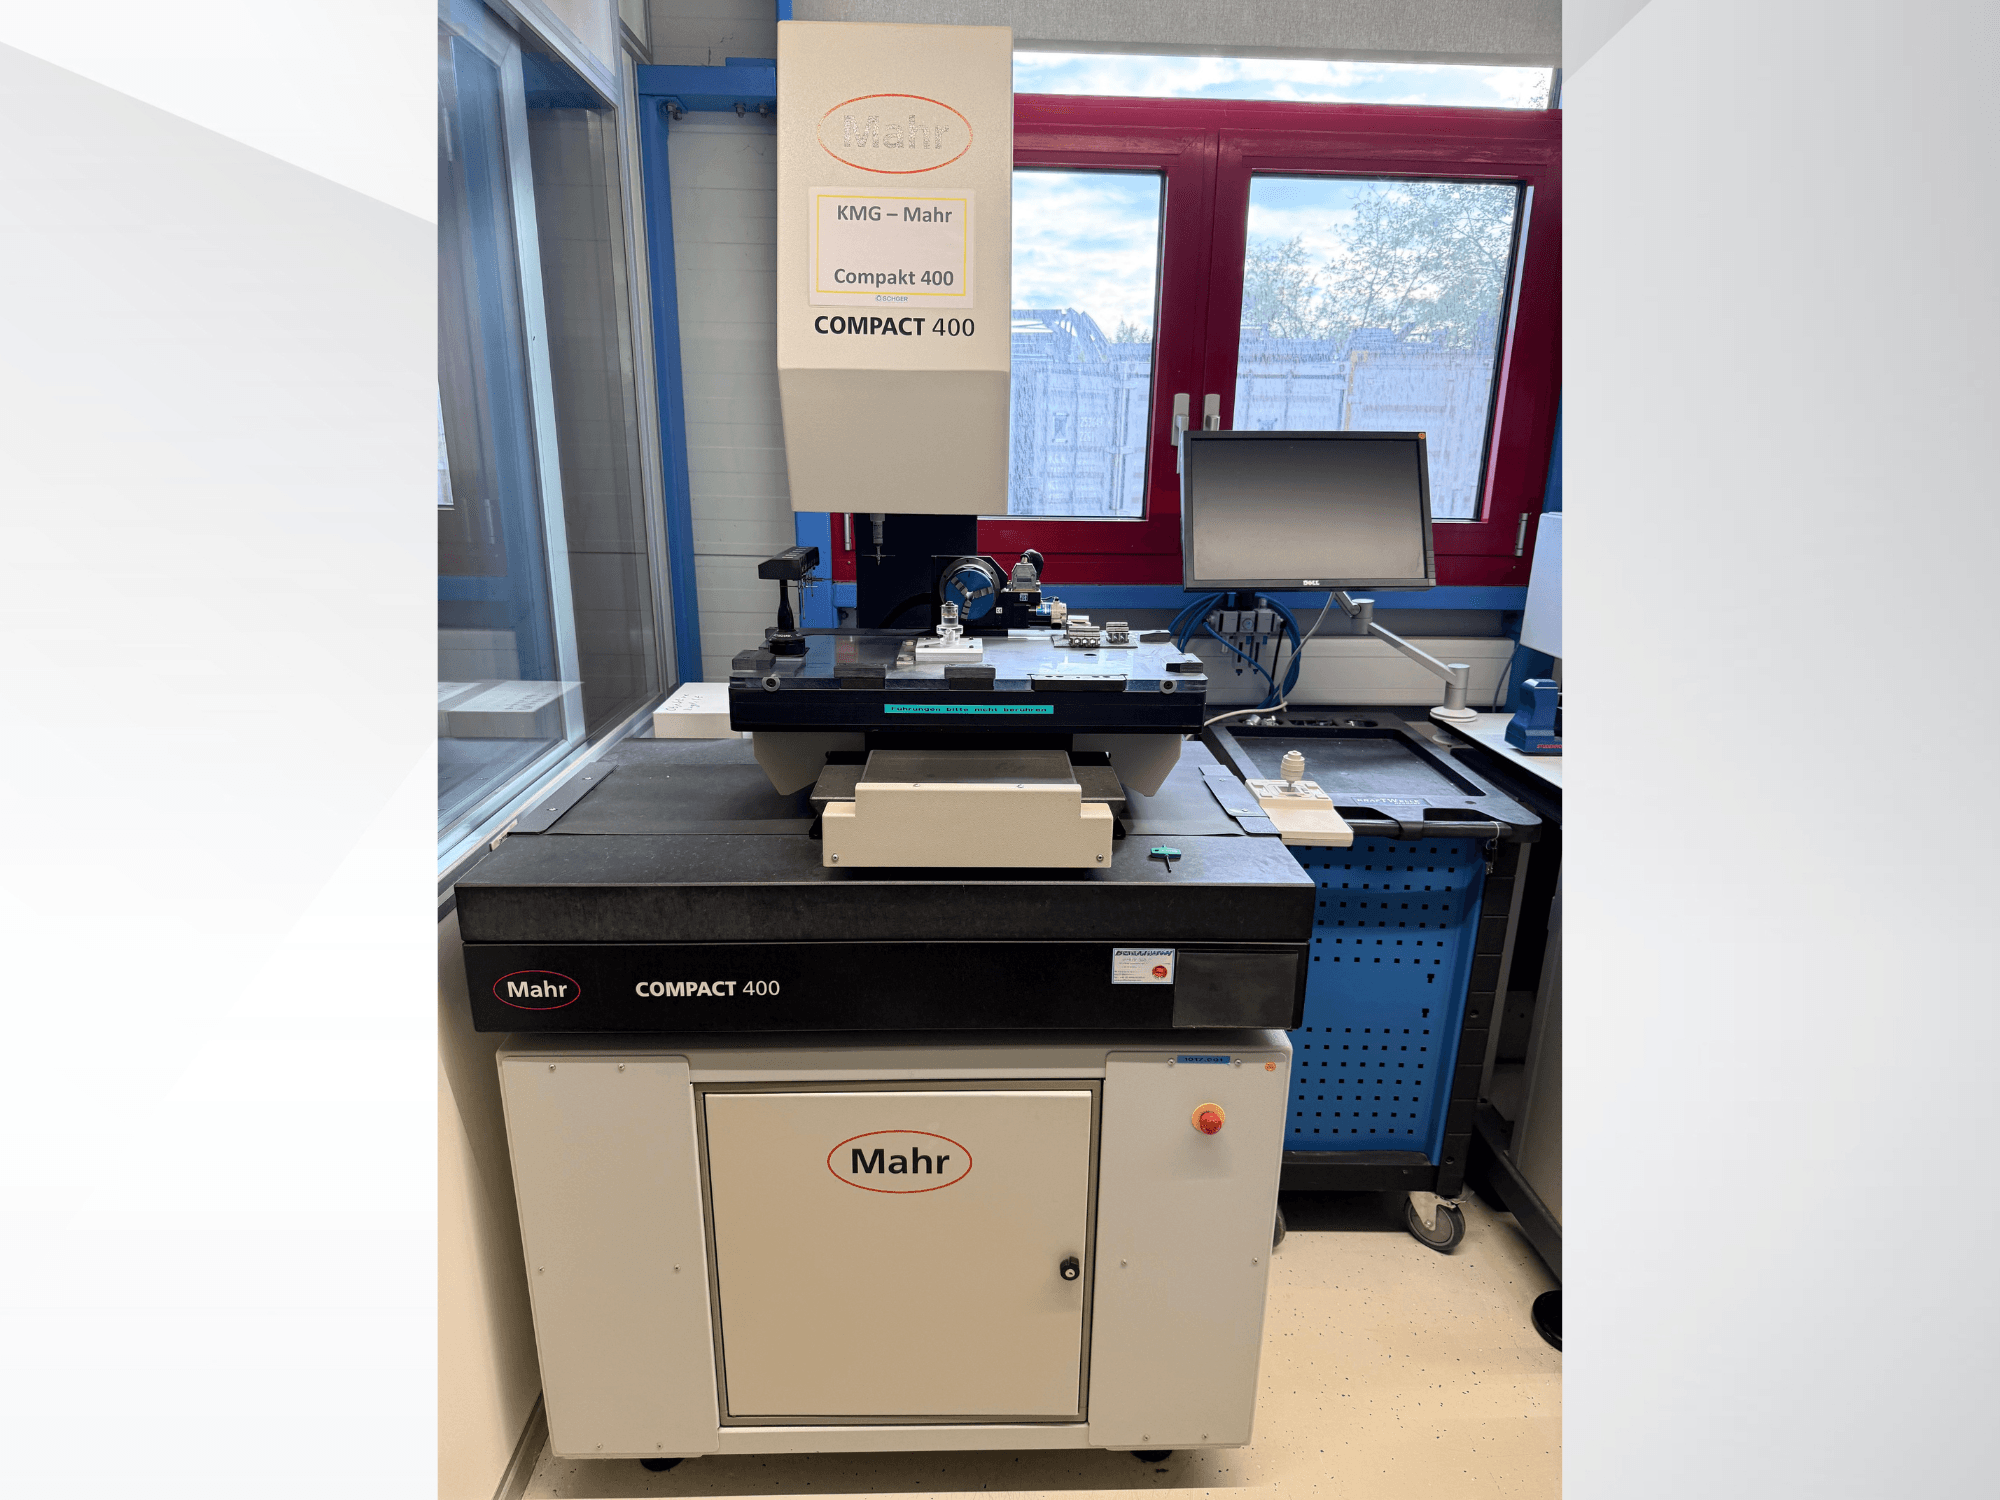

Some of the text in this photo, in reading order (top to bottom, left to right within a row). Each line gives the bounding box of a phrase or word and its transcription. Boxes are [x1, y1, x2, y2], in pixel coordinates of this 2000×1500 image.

[843, 114, 950, 149] Mahr
[837, 205, 882, 221] KMG
[903, 206, 953, 223] Mahr
[834, 268, 954, 288] Compakt 400
[814, 315, 975, 337] COMPACT 400
[507, 980, 568, 998] Mahr
[635, 980, 781, 997] COMPACT 400
[851, 1147, 950, 1174] Mahr
